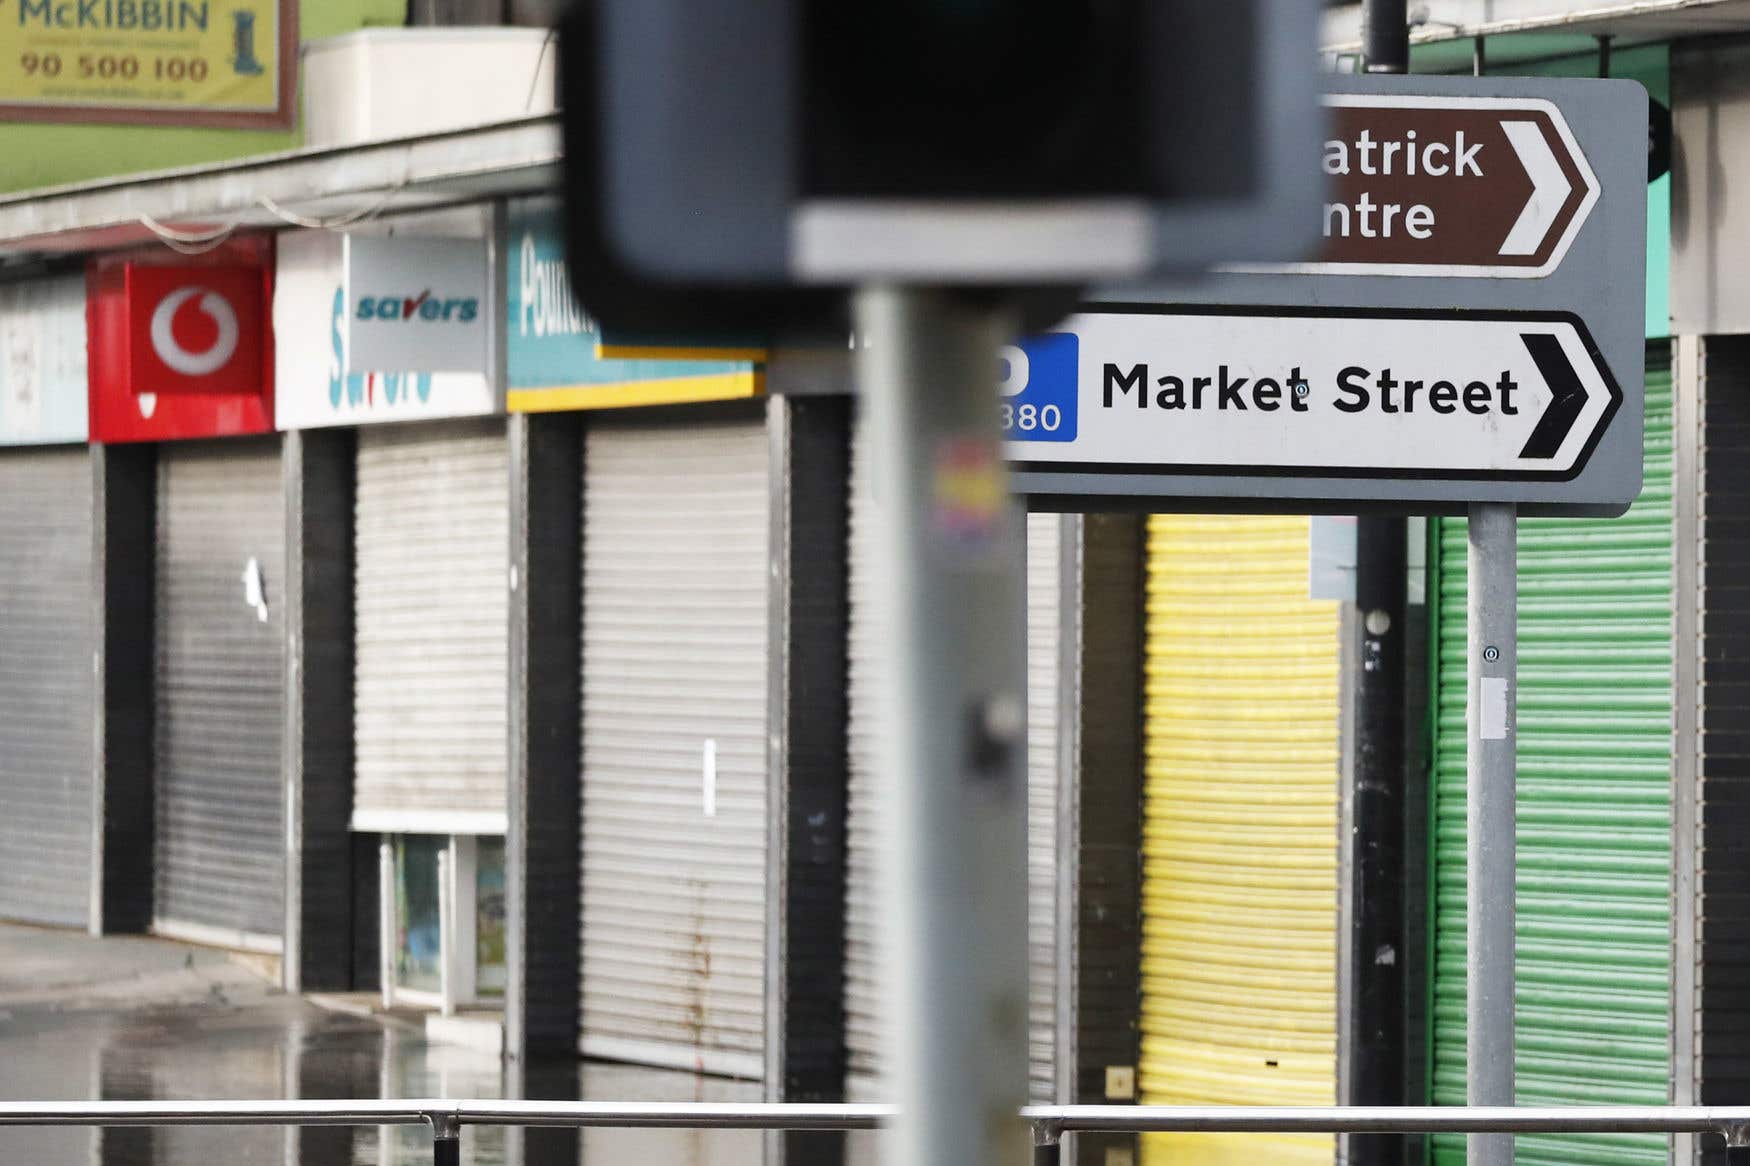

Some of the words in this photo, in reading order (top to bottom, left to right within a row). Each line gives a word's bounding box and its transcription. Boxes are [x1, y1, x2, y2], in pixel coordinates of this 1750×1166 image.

[21, 52, 62, 77] 90
[78, 55, 139, 80] 500
[155, 57, 208, 82] 100
[1321, 129, 1484, 177] atrick
[1322, 192, 1435, 239] ntre
[356, 288, 479, 322] savers
[1103, 363, 1309, 411] Market
[1333, 366, 1519, 415] Street
